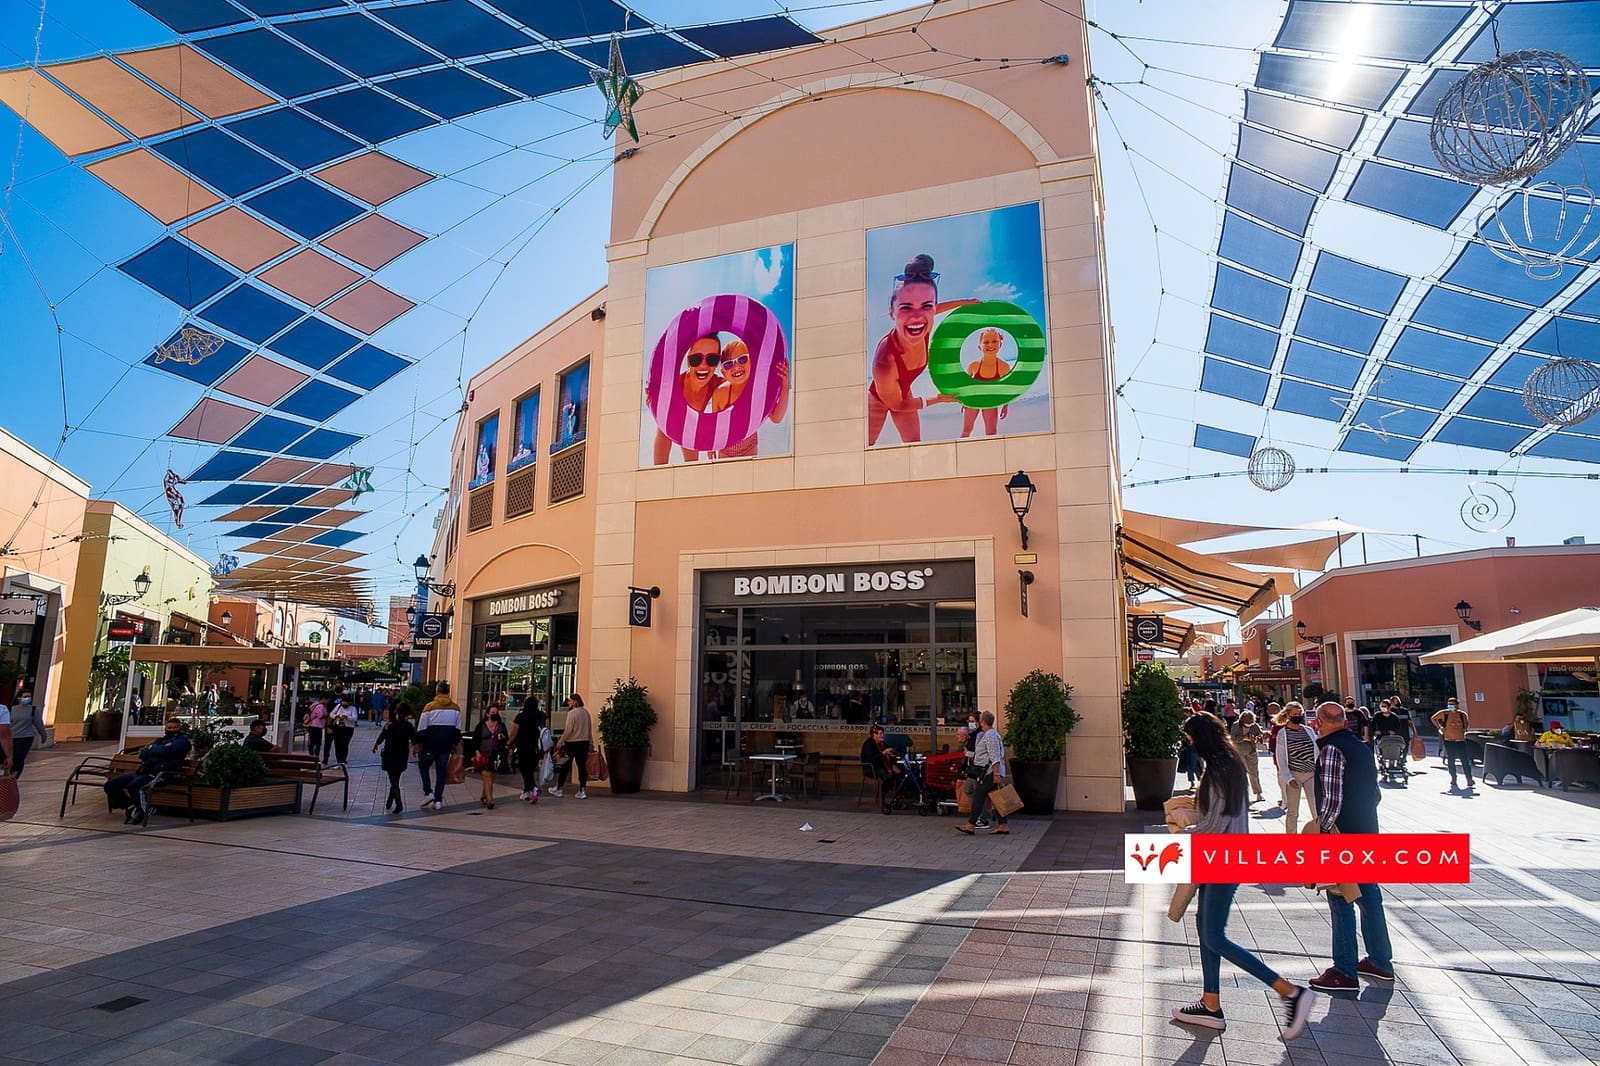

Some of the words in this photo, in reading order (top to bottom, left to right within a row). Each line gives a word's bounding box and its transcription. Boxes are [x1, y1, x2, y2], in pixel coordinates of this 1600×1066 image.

[734, 572, 845, 596] BOMBON
[489, 596, 527, 616] BOMBON
[415, 637, 433, 646] VANS
